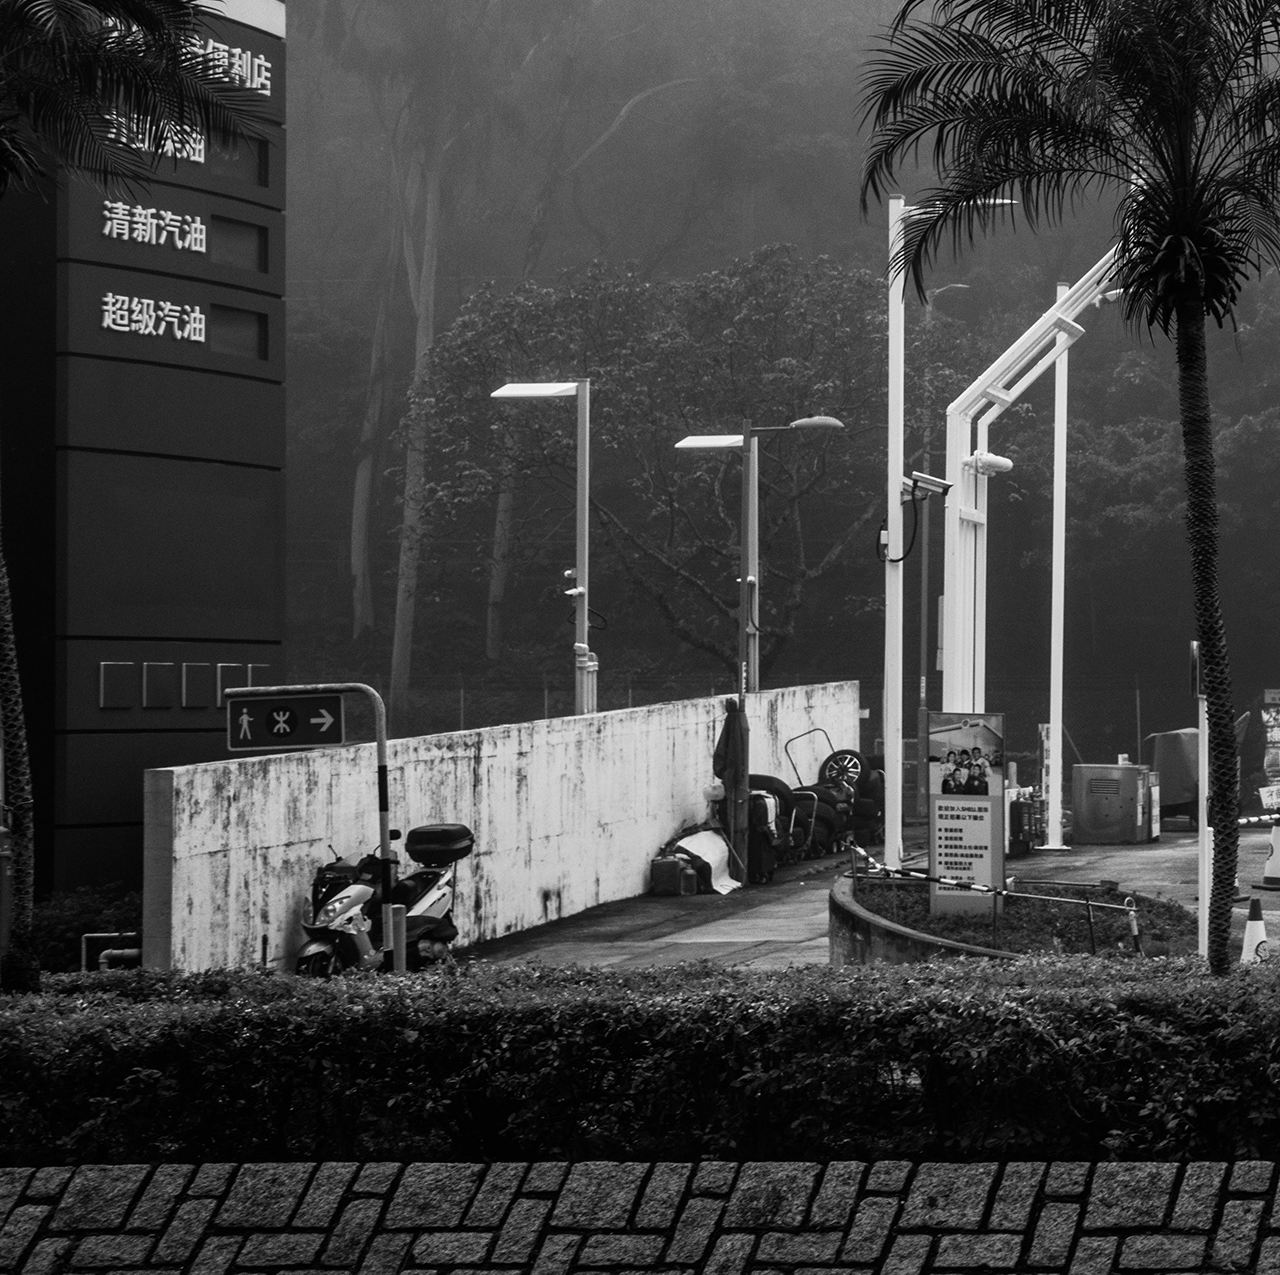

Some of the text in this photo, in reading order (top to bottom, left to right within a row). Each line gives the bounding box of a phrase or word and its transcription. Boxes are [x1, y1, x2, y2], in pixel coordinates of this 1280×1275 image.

[102, 199, 207, 253] 清新汽油
[101, 291, 206, 343] 超級汽油
